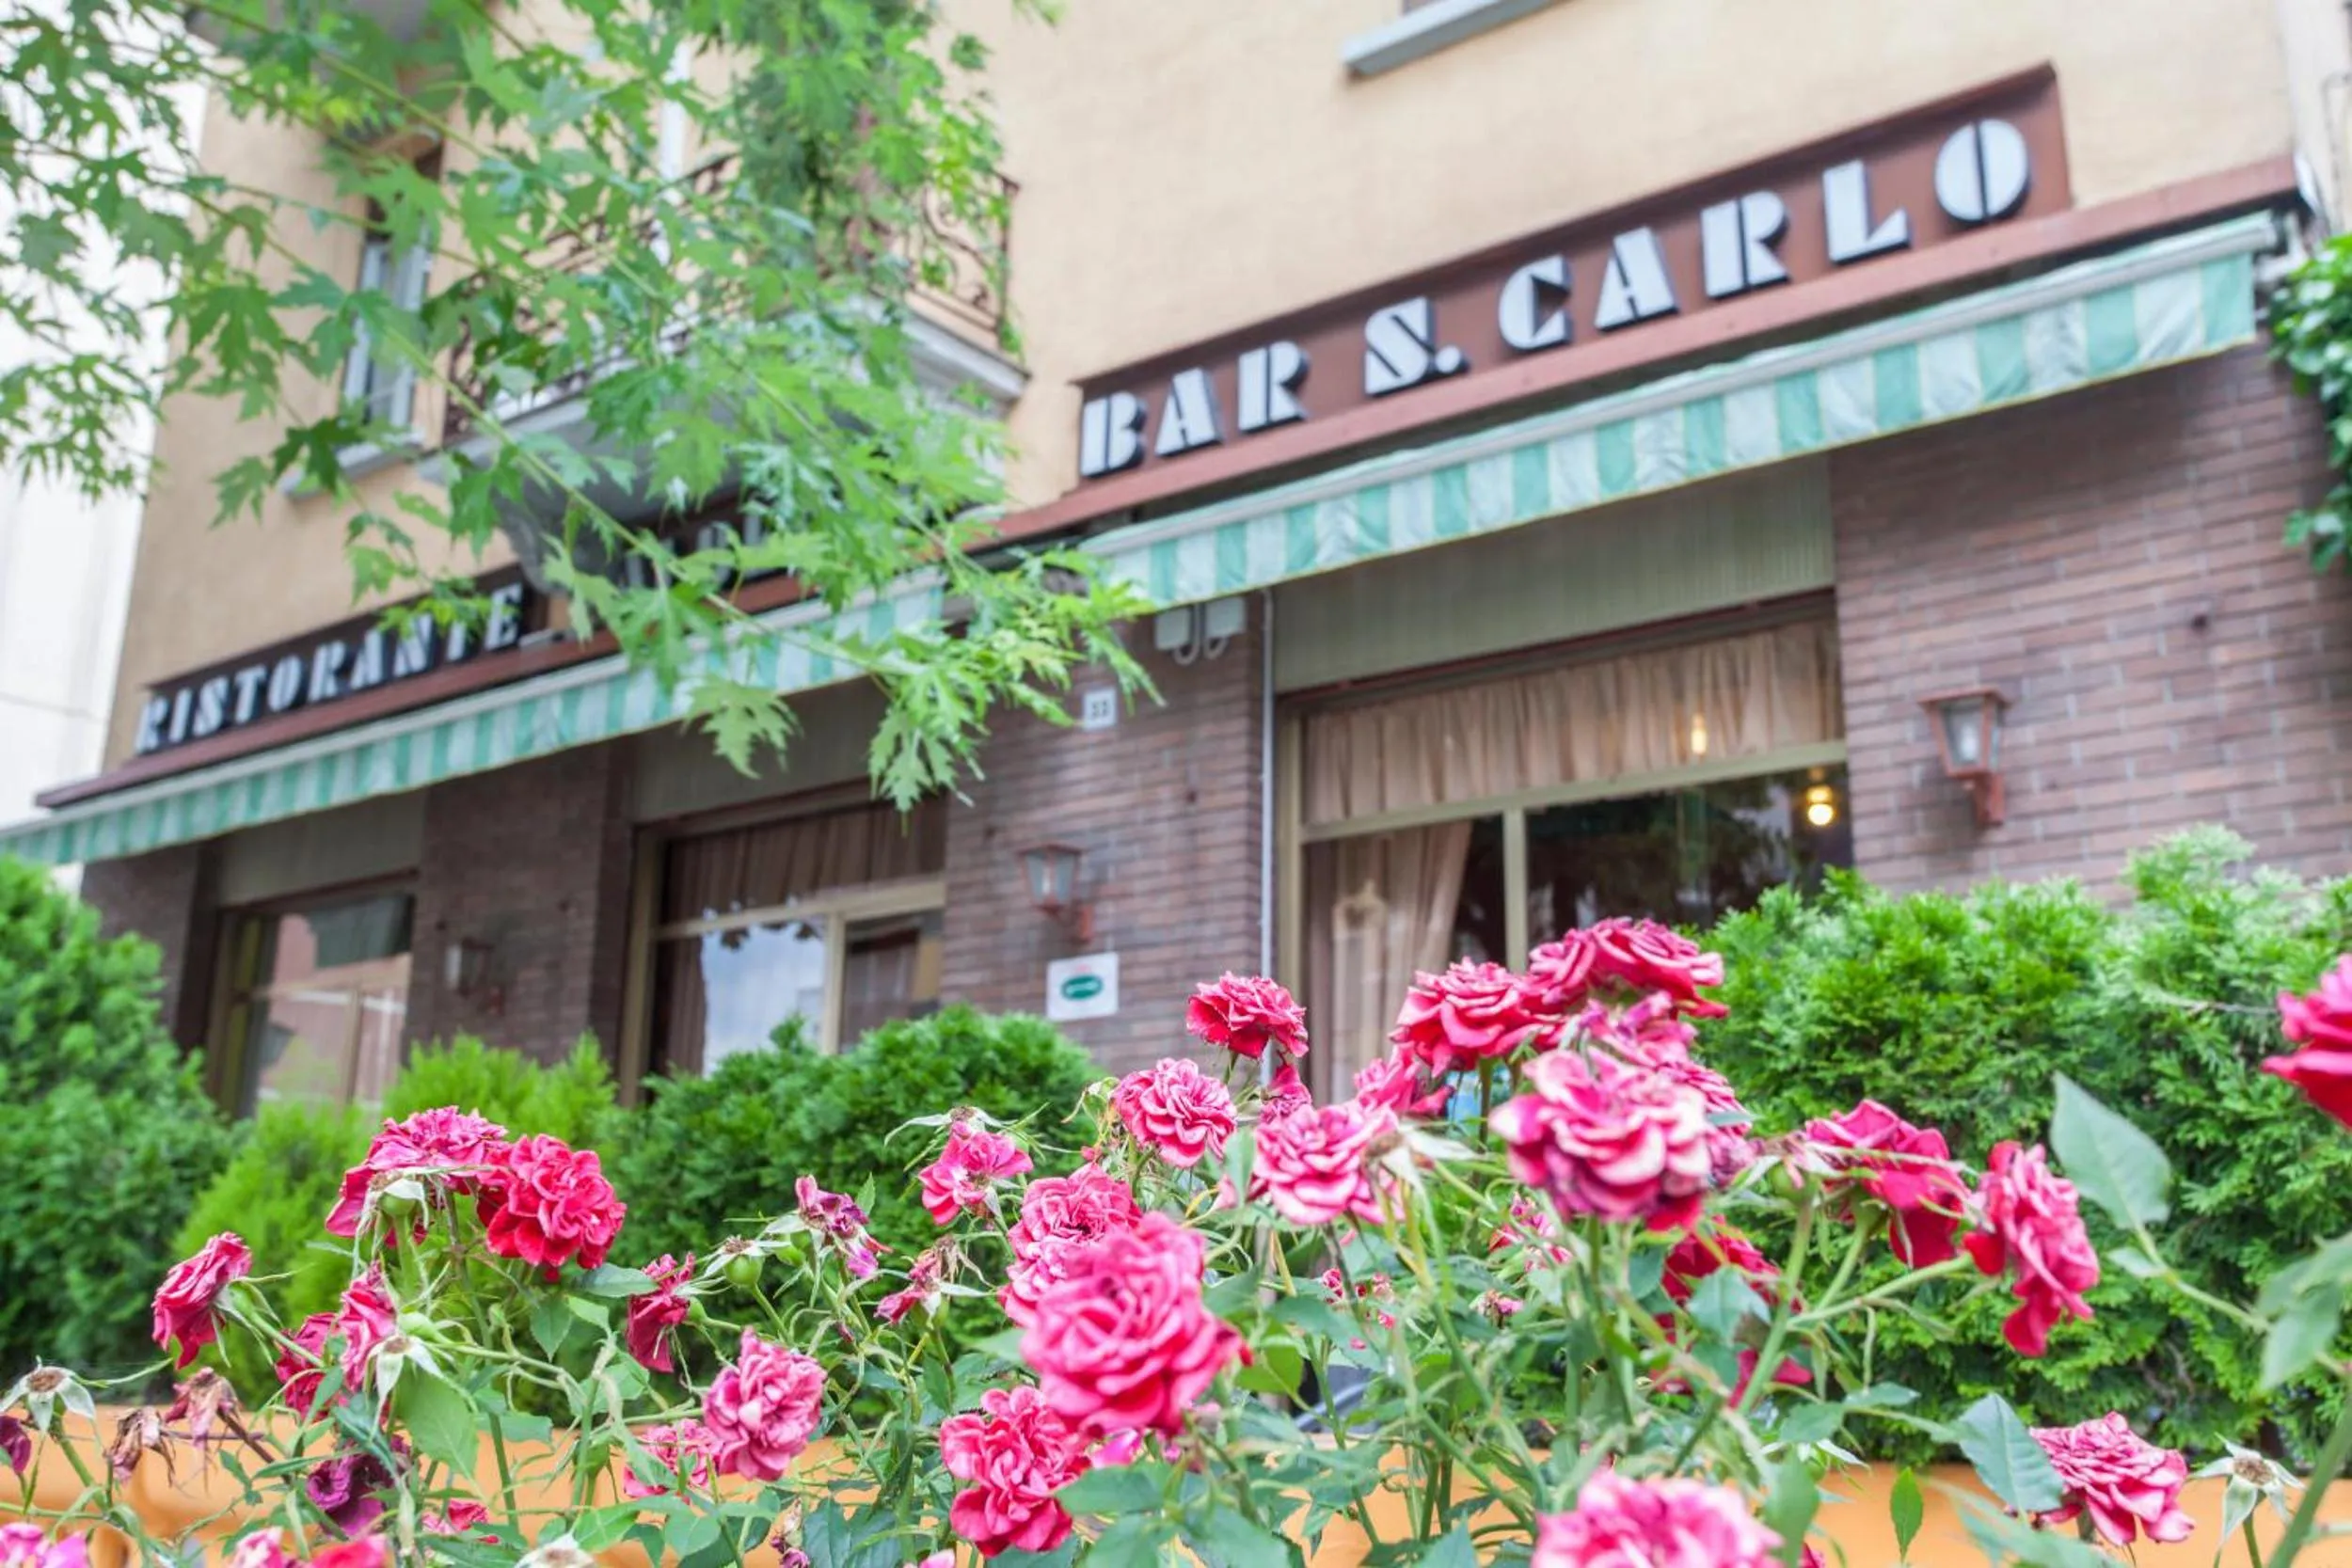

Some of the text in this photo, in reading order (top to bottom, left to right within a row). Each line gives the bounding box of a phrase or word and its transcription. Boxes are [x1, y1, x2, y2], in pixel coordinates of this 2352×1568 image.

[1081, 118, 2030, 479] BAR S. CARLO
